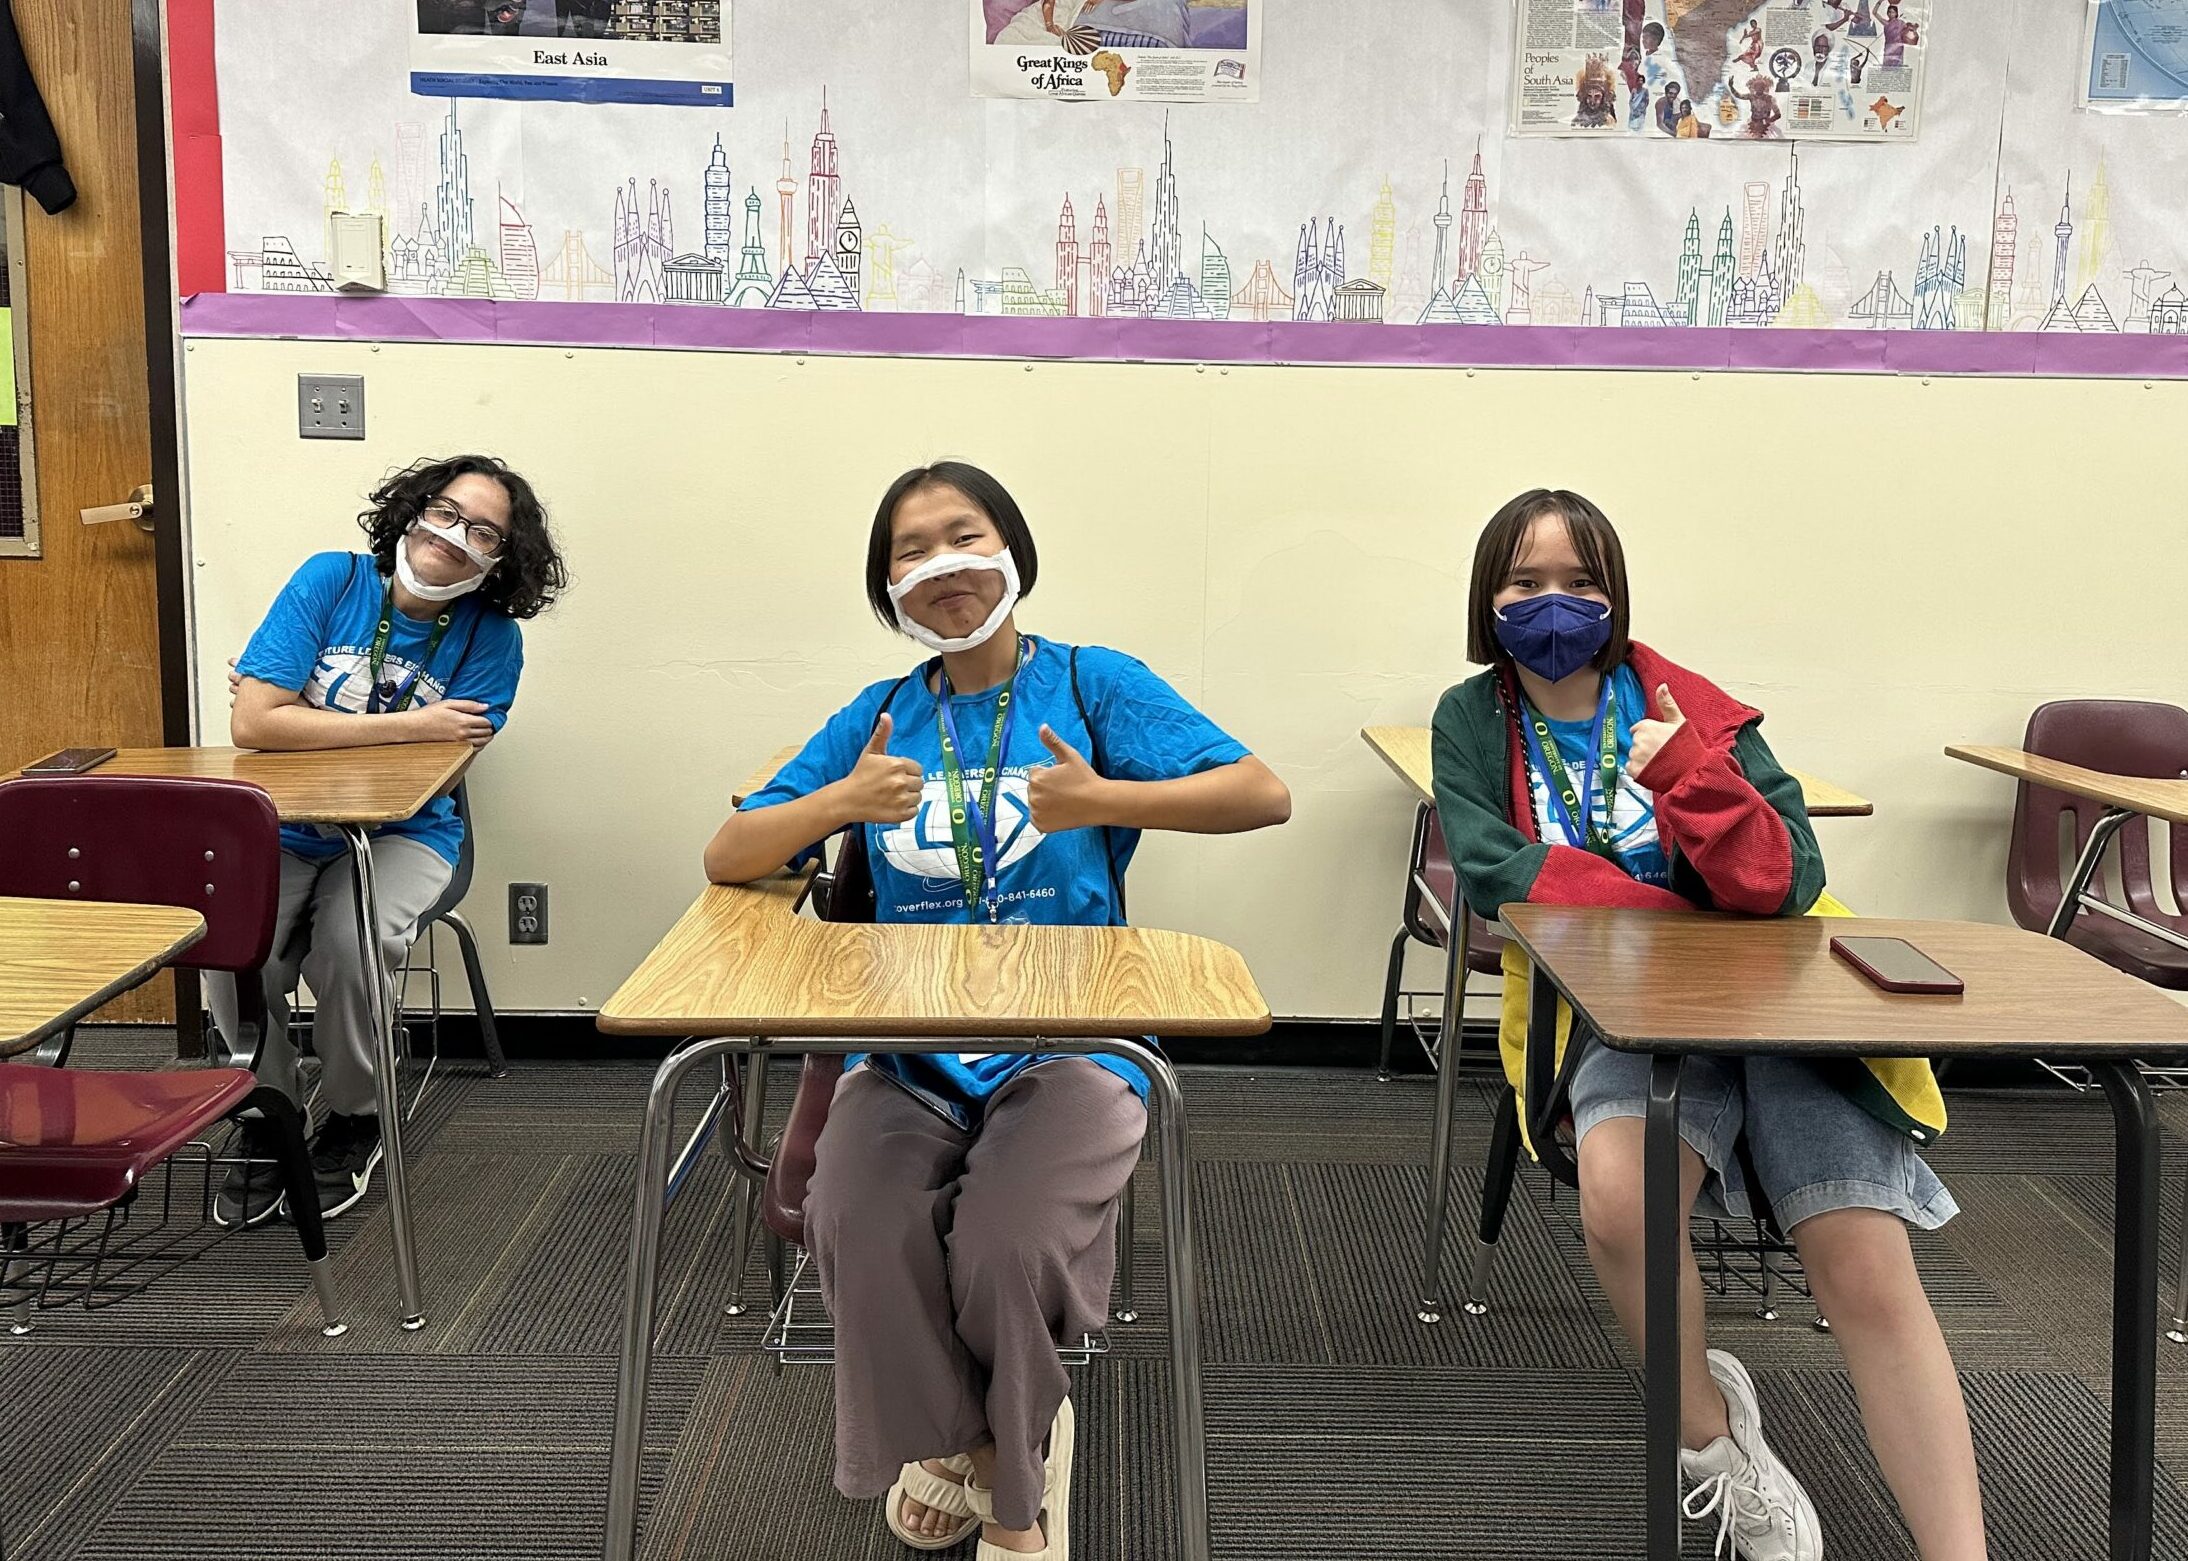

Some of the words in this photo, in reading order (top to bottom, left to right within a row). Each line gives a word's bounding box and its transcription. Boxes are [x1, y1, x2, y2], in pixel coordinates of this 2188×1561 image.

[533, 50, 568, 65] East
[572, 51, 608, 66] Asia
[1017, 55, 1052, 72] Great
[1050, 56, 1088, 73] Kings
[1525, 52, 1559, 66] Peoples
[1524, 63, 1535, 74] of
[1031, 73, 1045, 89] of
[1043, 74, 1083, 89] Africa
[1524, 74, 1552, 85] South
[1552, 75, 1574, 85] Asia
[379, 620, 390, 634] O
[320, 645, 356, 656] TURE
[358, 647, 403, 666] LEERS
[998, 691, 1010, 707] O
[1535, 721, 1548, 736] O
[1606, 717, 1614, 749] OREGON
[1541, 740, 1559, 775] OREGON
[1602, 754, 1615, 769] O
[928, 768, 985, 781] LEERS
[1001, 766, 1030, 781] CHAN
[984, 767, 995, 783] O
[953, 769, 963, 803] OREGON
[1562, 789, 1576, 806] O
[952, 808, 966, 825] O
[979, 887, 1056, 905] 1-0-841-6460
